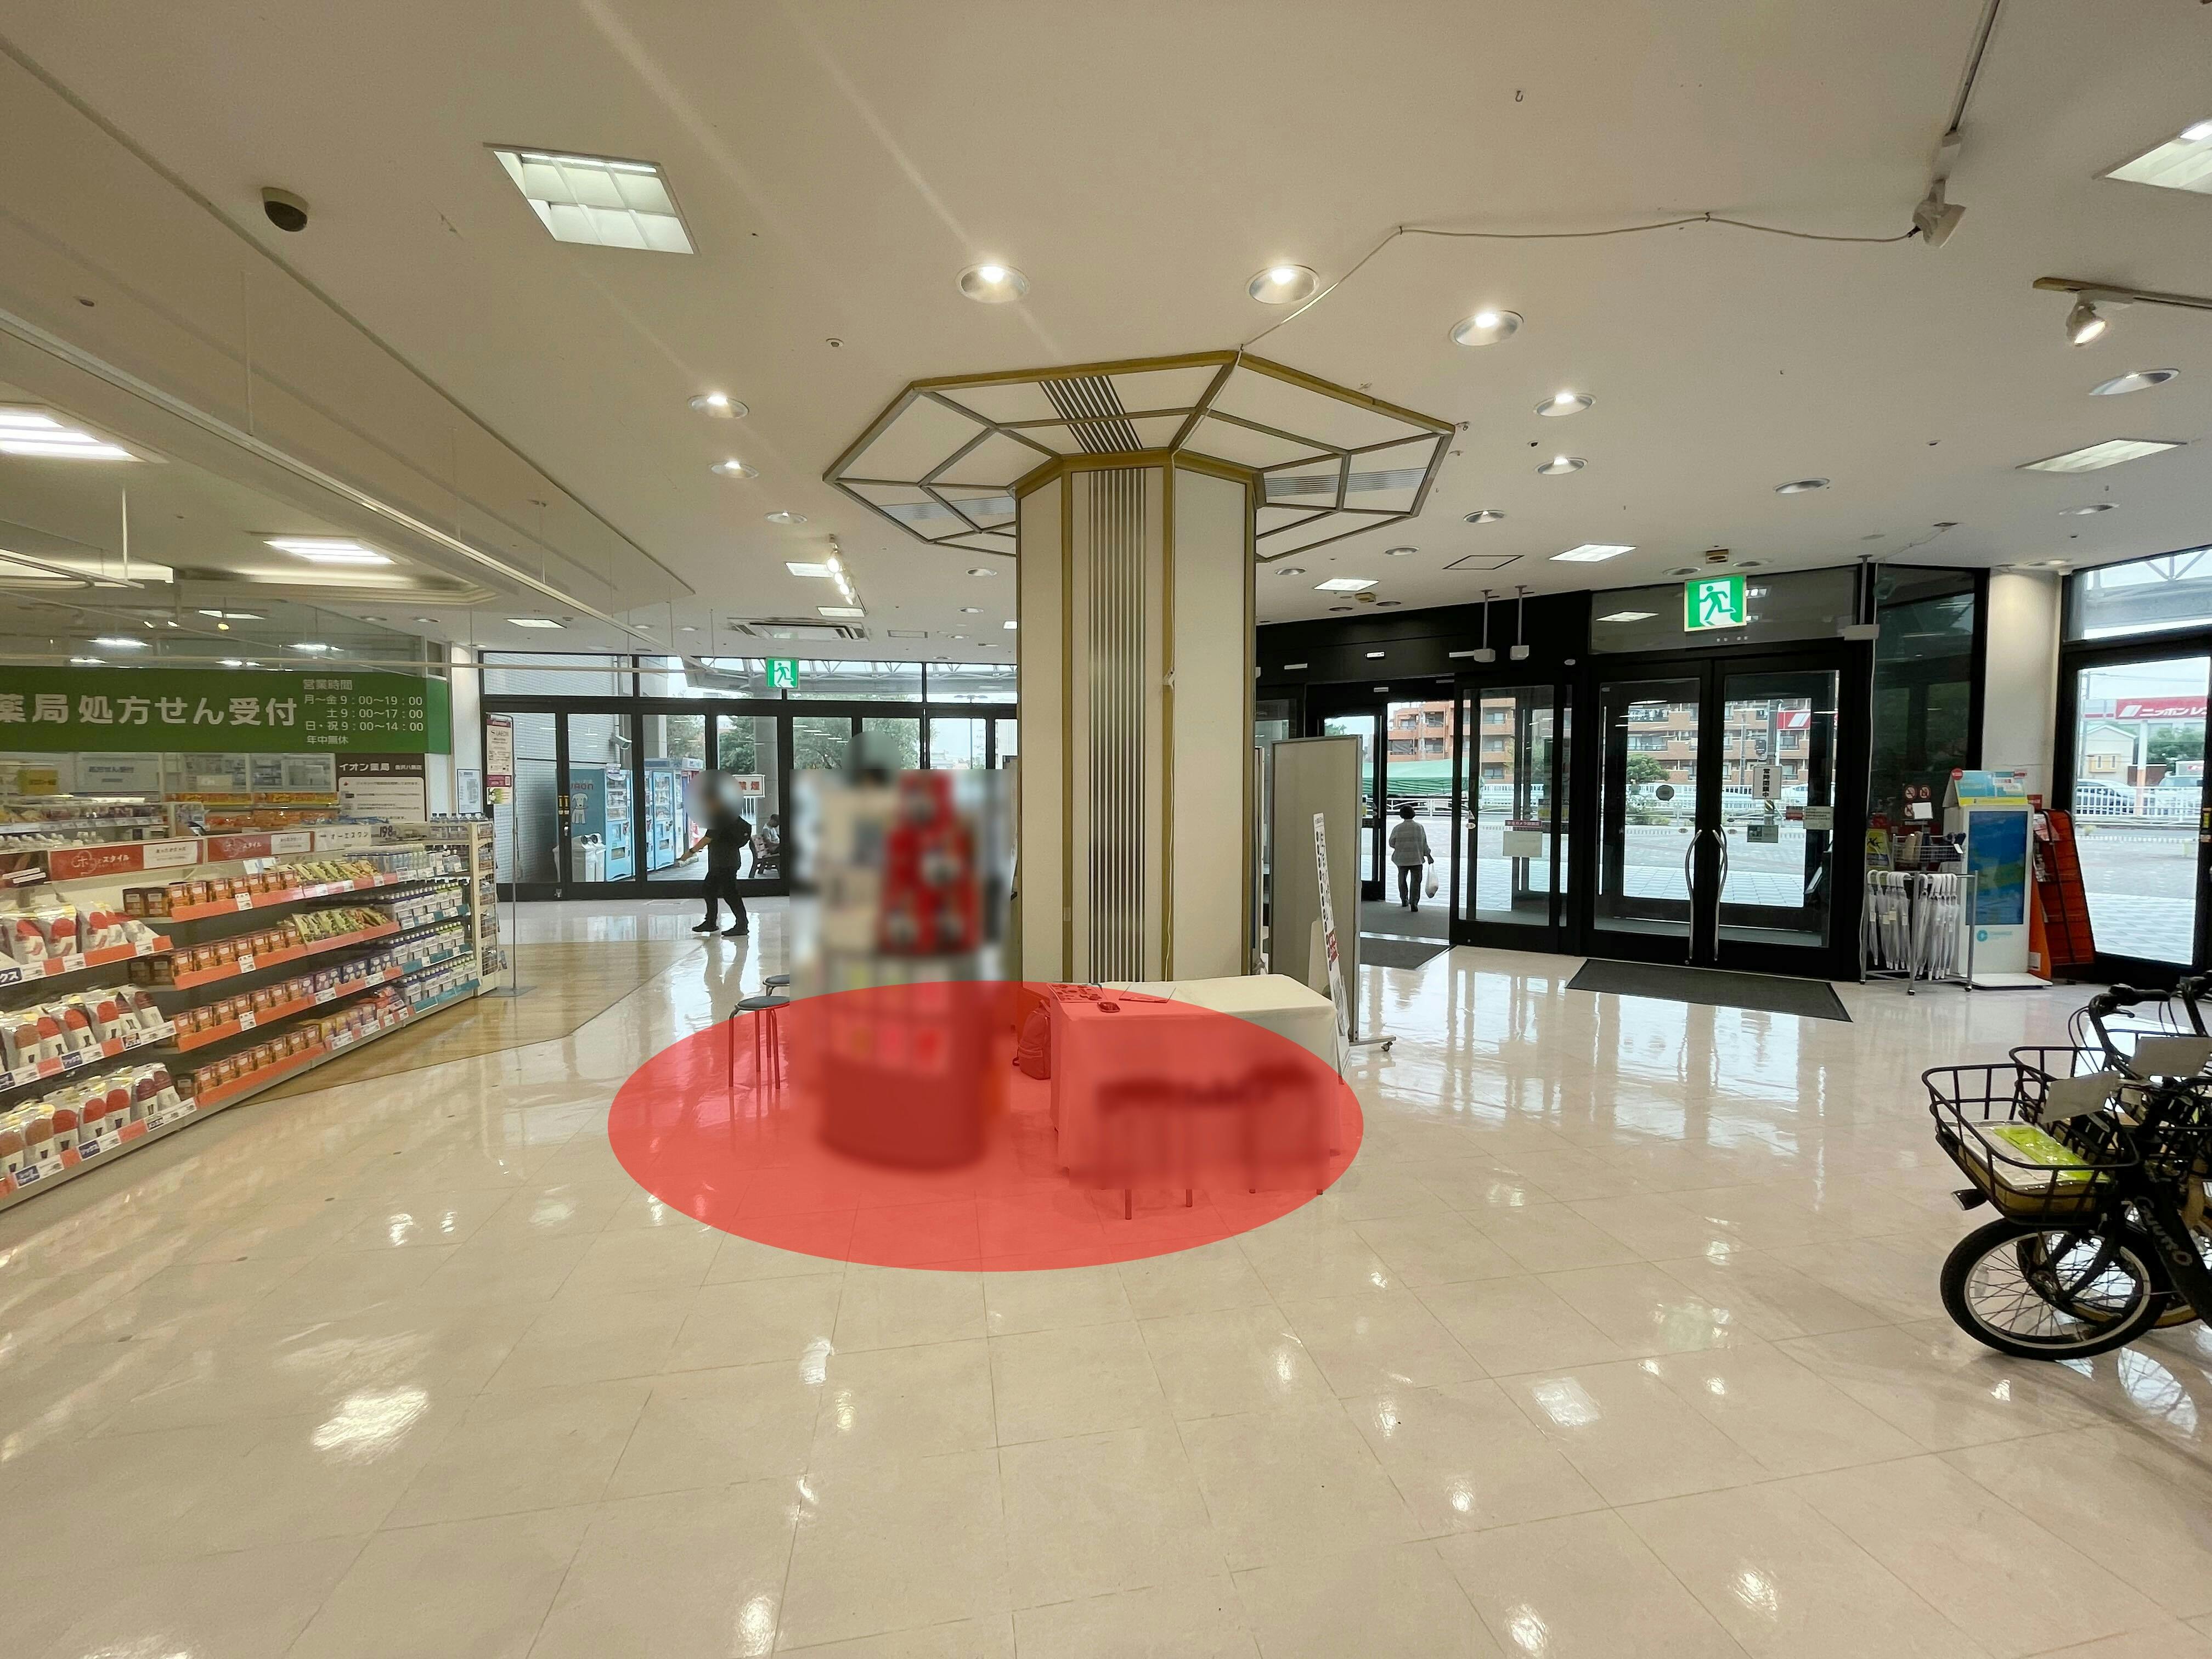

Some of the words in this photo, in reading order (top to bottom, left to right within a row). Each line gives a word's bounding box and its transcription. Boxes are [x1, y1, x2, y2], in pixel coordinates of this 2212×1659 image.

[303, 679, 353, 690] 営業時間
[78, 695, 297, 726] 処方せん受付
[307, 735, 349, 744] 年中無休
